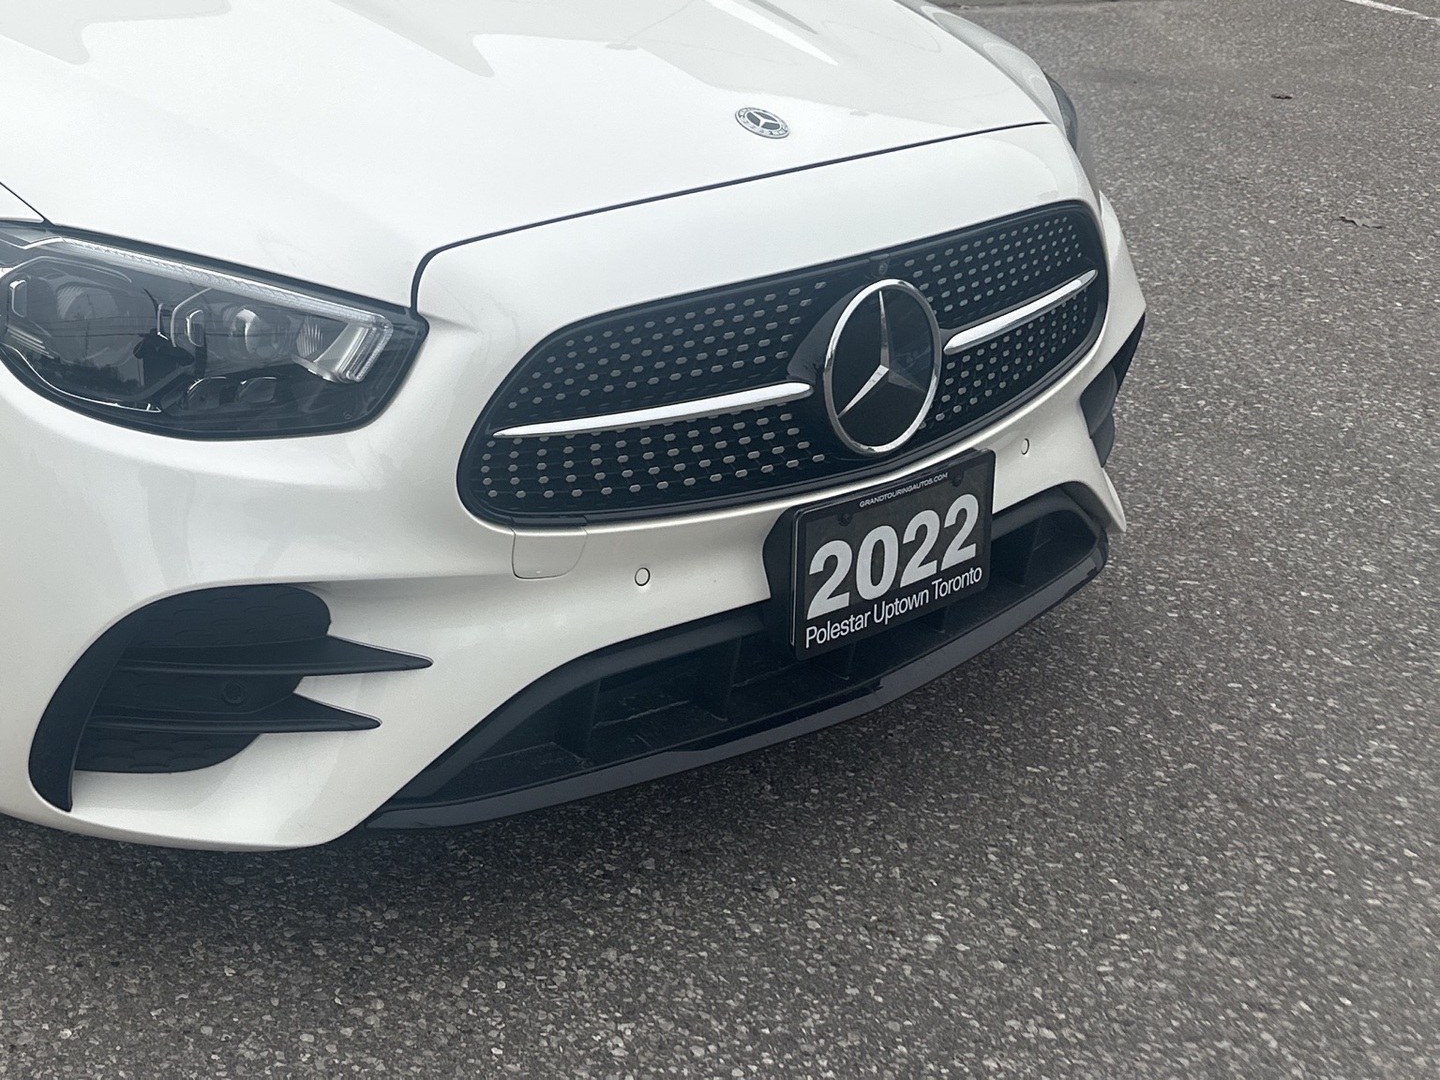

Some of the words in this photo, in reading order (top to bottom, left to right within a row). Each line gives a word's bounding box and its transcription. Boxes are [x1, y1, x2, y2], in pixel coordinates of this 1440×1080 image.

[859, 472, 949, 508] GRANDTOURINGAUTOS.COM
[807, 494, 980, 620] 2022
[805, 610, 872, 649] Polestar
[873, 589, 930, 625] Uptown
[931, 566, 983, 600] Toronto
